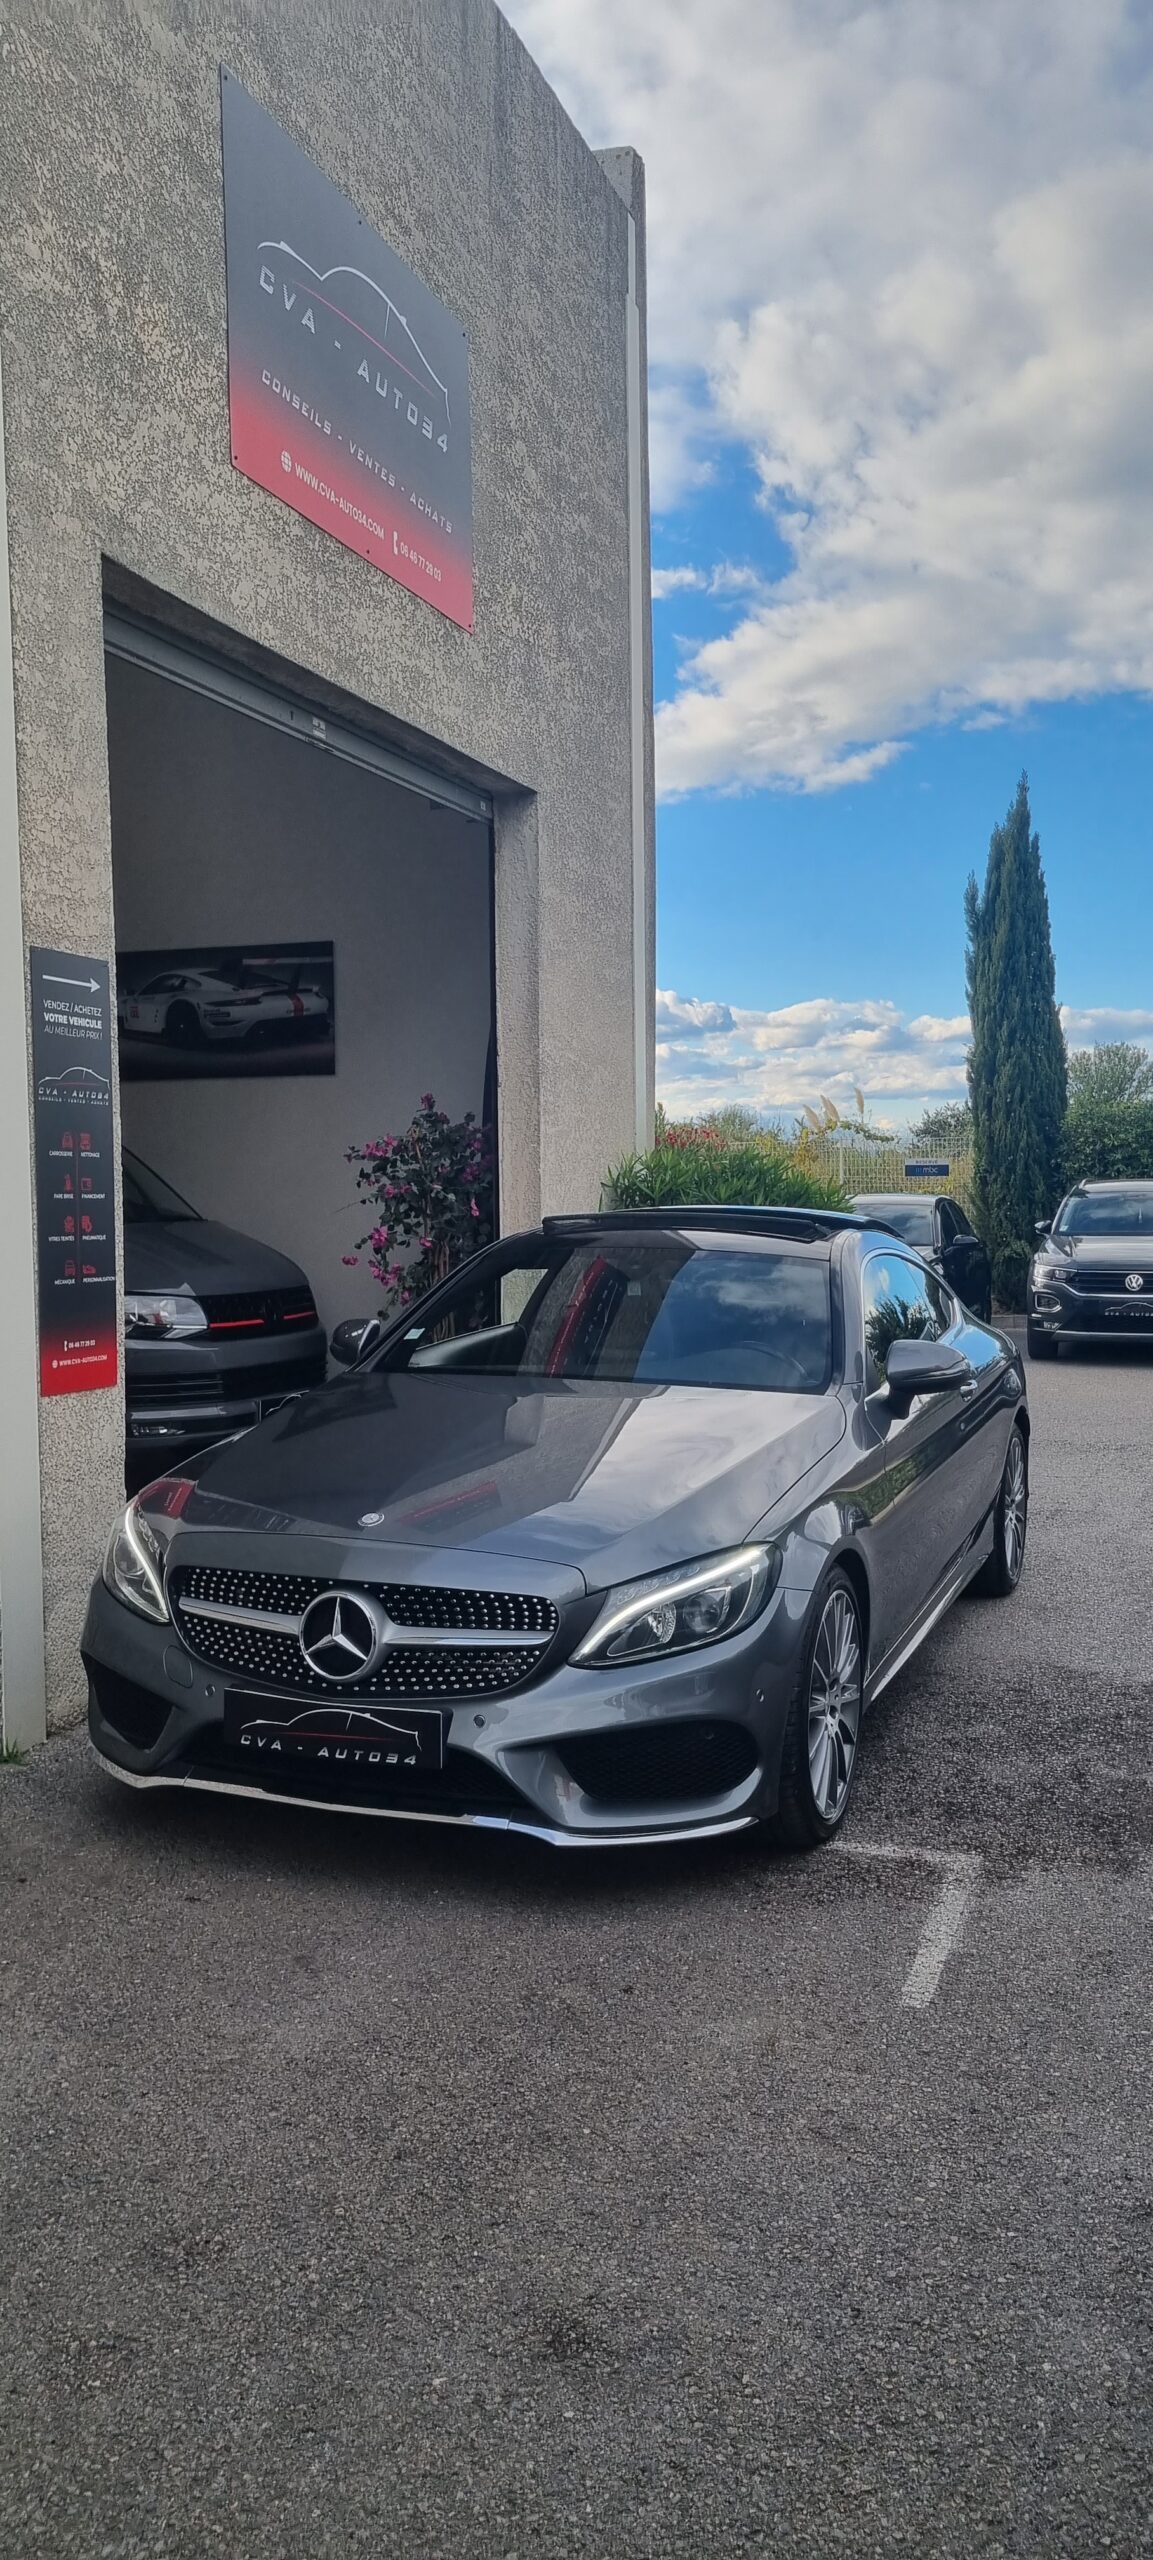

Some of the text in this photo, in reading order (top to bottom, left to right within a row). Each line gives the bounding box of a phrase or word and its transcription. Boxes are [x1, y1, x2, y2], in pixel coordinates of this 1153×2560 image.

[259, 265, 316, 334] CVA
[356, 359, 449, 453] AUTO34
[261, 369, 332, 435] CONSEILS
[349, 440, 396, 487] VENTES
[409, 490, 454, 534] ACHATS
[294, 462, 385, 540] WWW.CVA-AUTO34.COM
[43, 999, 70, 1012] VENDEZ
[73, 1004, 102, 1017] ACHETEZ
[43, 1012, 102, 1029] VOTRE VEHICULE
[44, 1024, 54, 1034] AU
[54, 1025, 86, 1039] MEILLEUR
[38, 1086, 58, 1095] CVA
[240, 1734, 282, 1751] CVA
[317, 1746, 417, 1765] AUTO34
